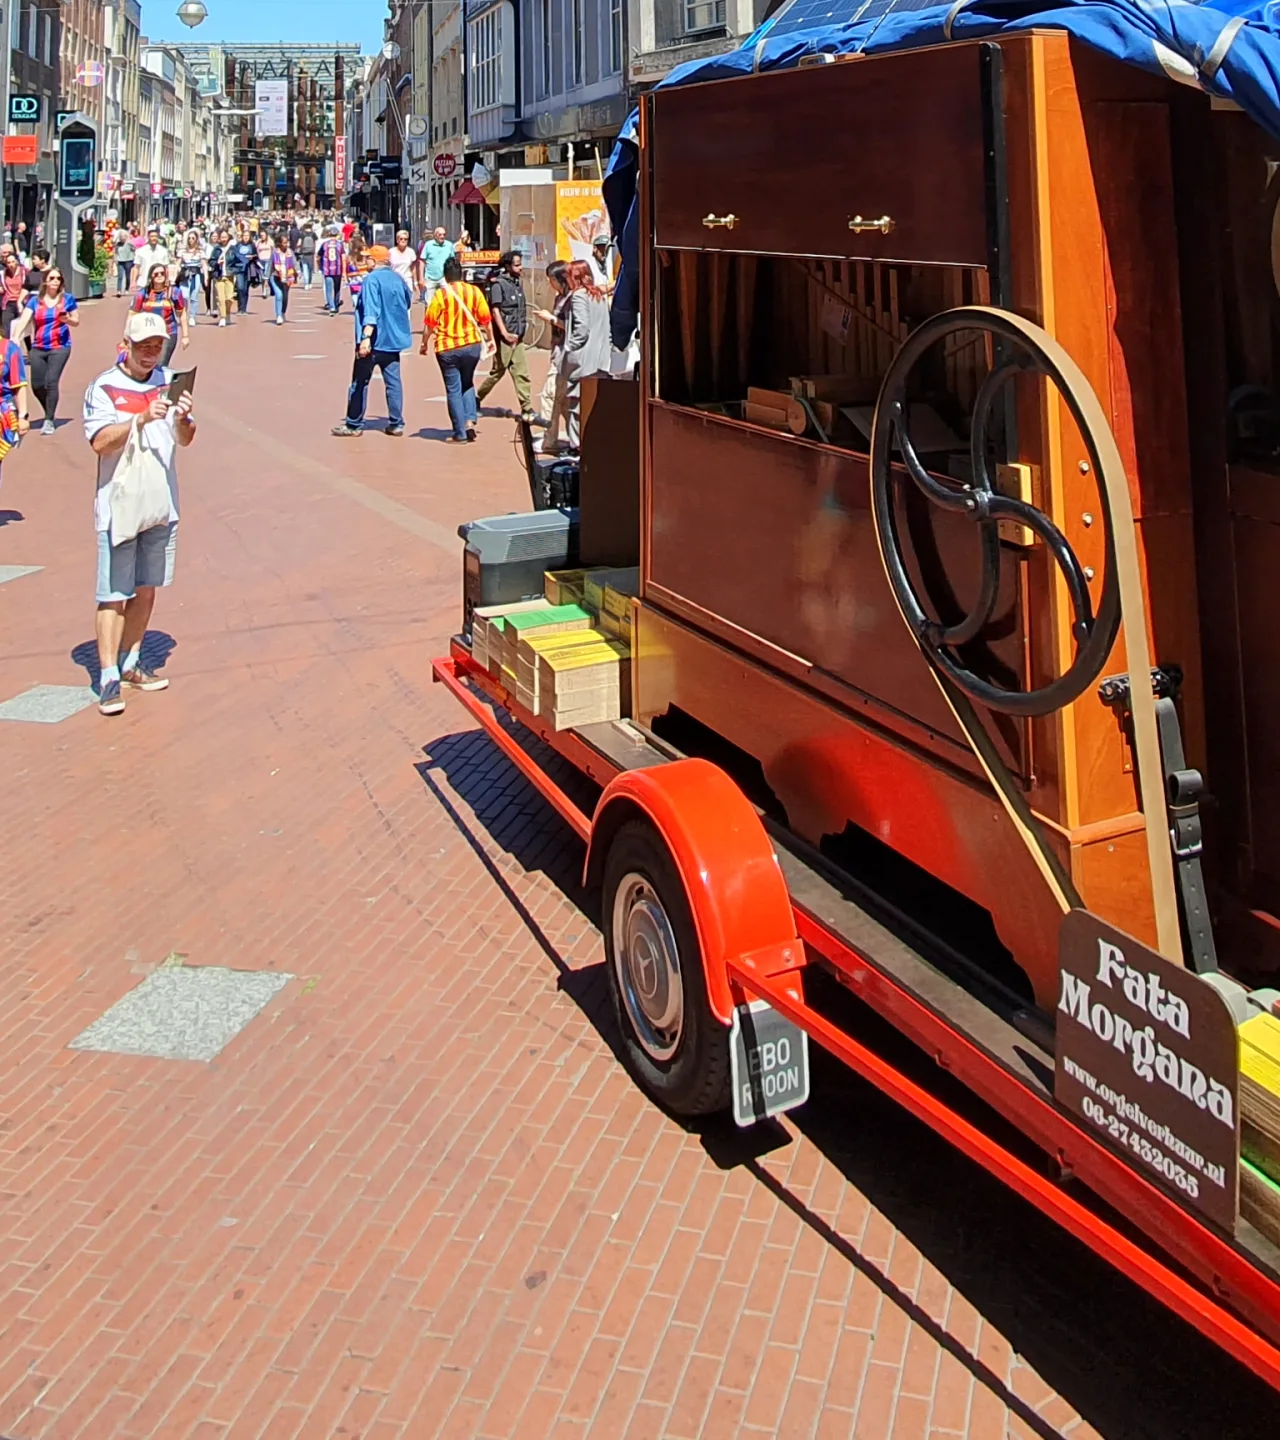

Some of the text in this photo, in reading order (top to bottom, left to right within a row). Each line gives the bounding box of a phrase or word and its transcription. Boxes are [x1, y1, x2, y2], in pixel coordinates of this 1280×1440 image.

[12, 97, 38, 114] DO
[1096, 938, 1191, 1040] Fata
[1058, 968, 1235, 1130] Morgana
[1081, 1095, 1200, 1200] 06-27432035
